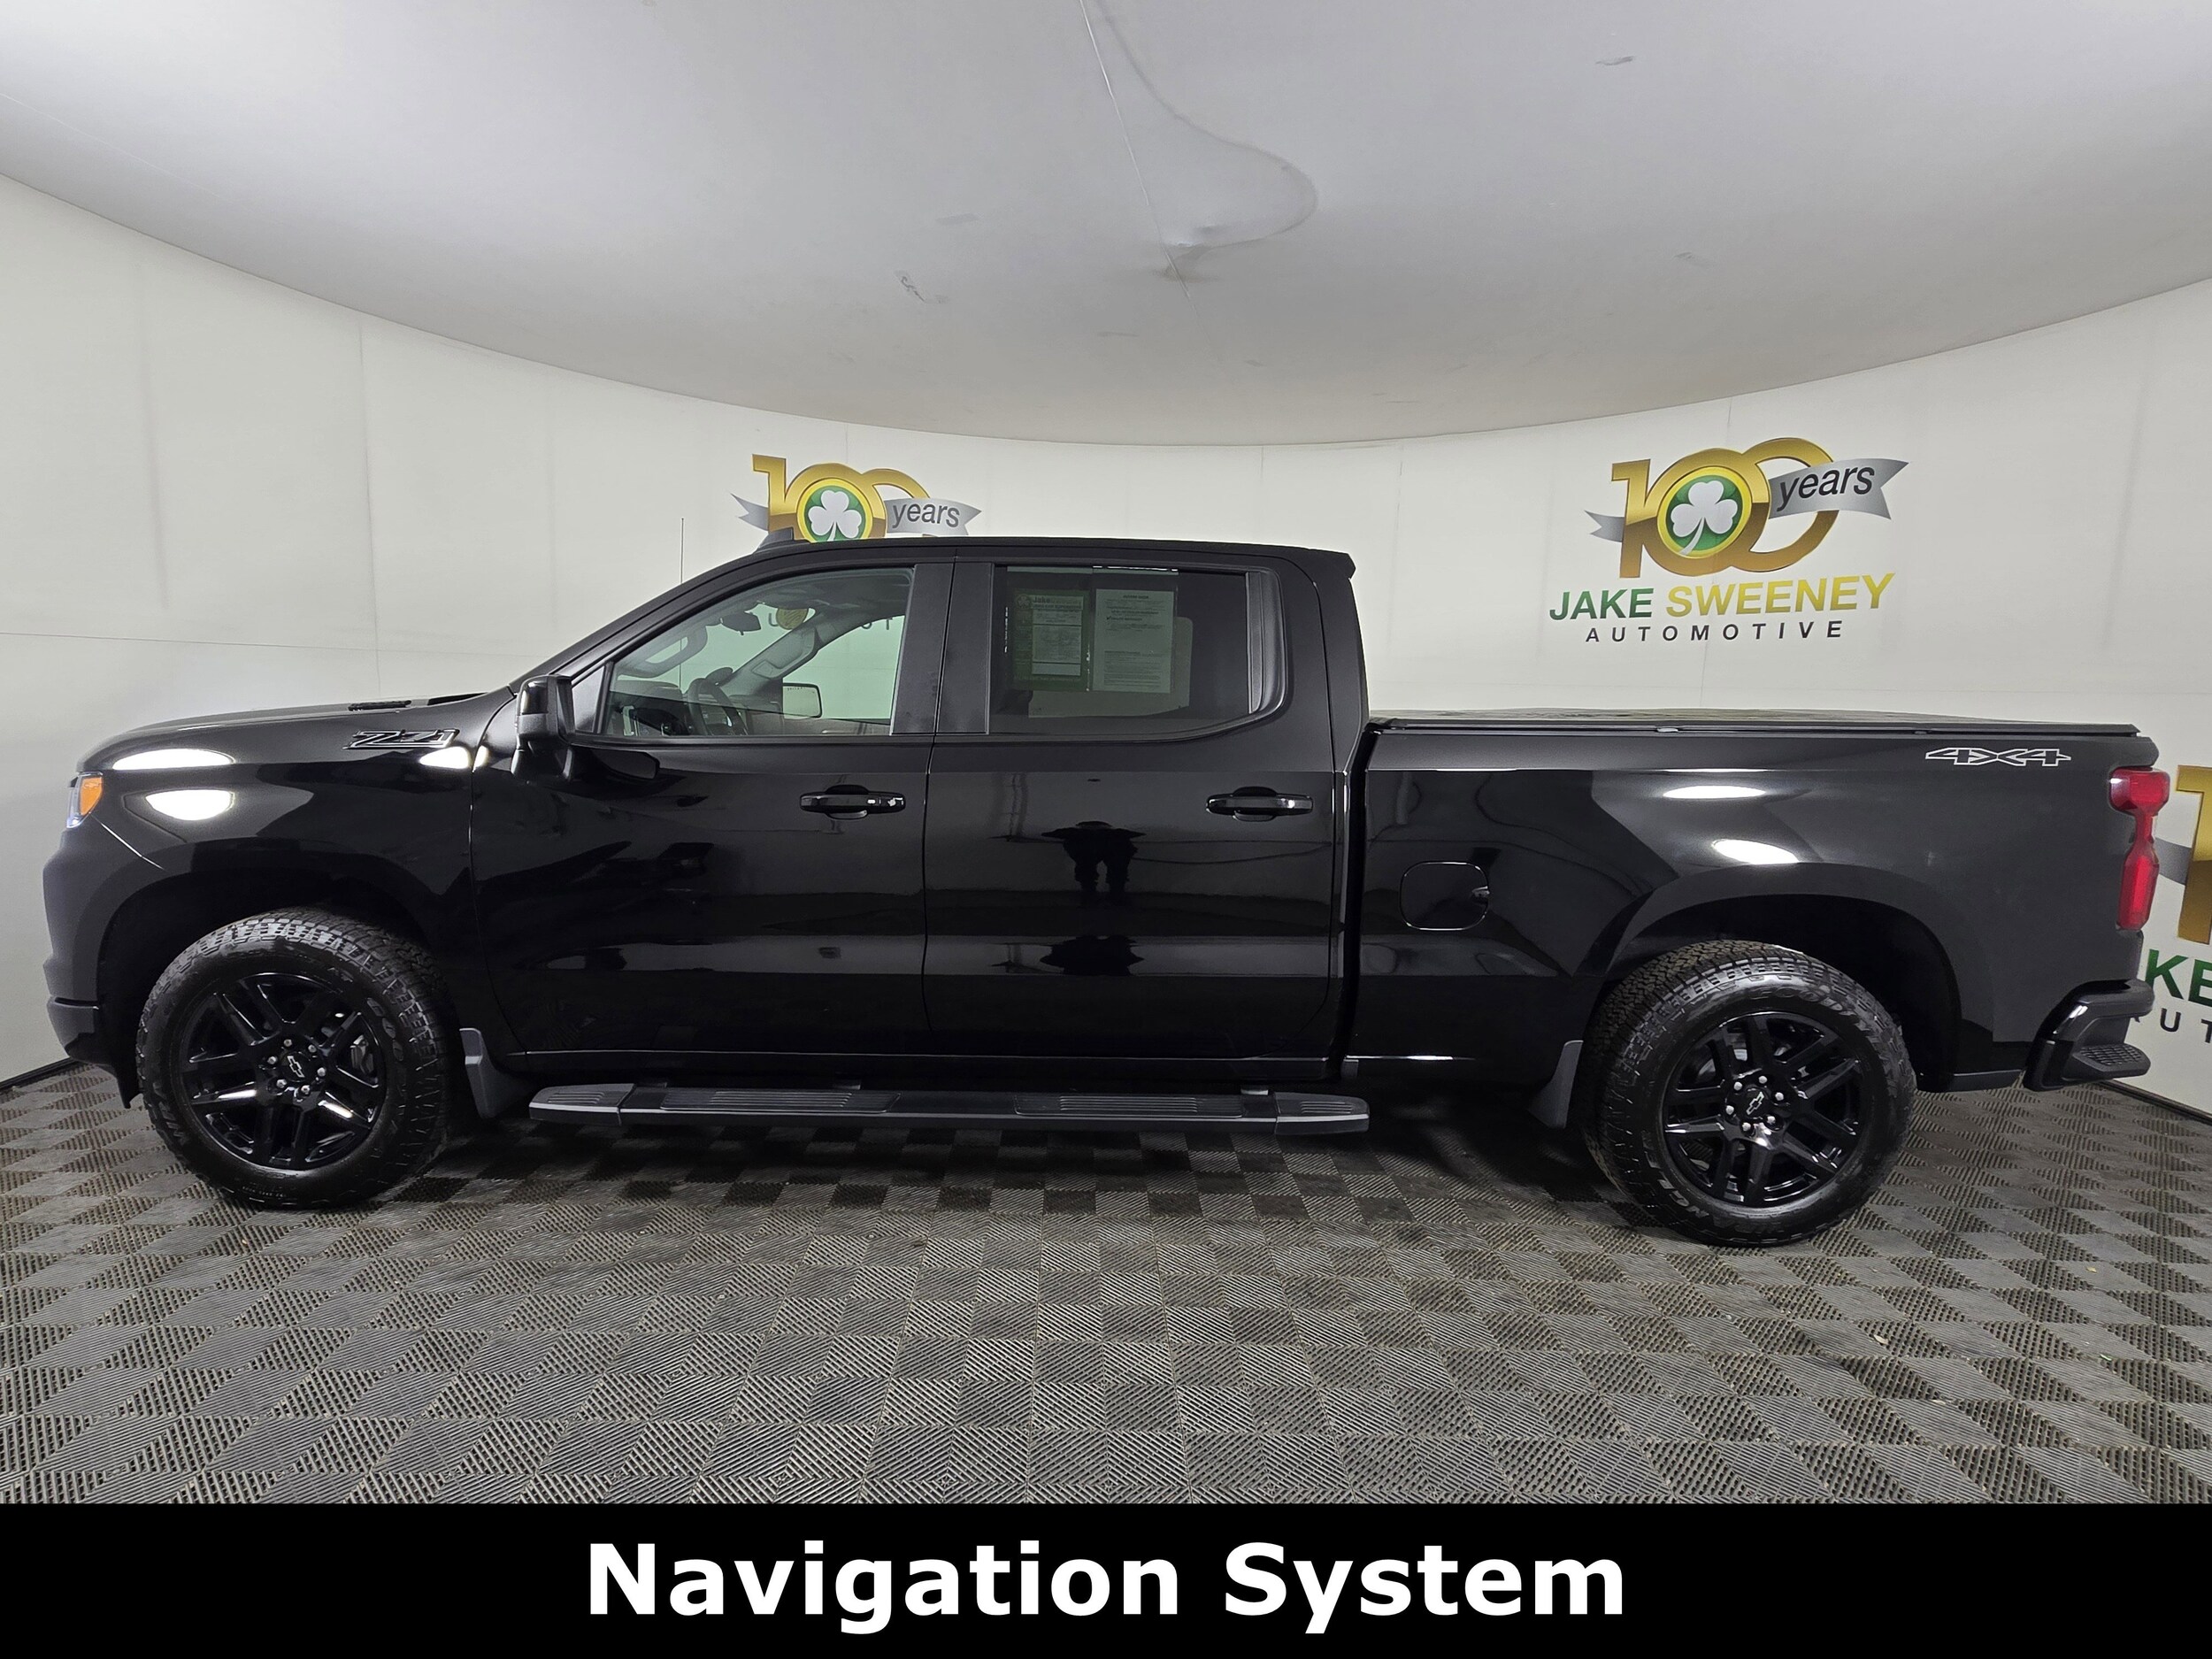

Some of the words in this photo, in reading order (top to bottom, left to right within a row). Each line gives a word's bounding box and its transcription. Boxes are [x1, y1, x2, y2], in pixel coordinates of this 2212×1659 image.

[1777, 466, 1875, 512] years
[891, 503, 961, 529] years
[1549, 587, 1655, 621] JAKE
[1666, 572, 1895, 618] SWEENEY
[1585, 620, 1843, 642] AUTOMOTIVE
[2145, 949, 2212, 1008] KE
